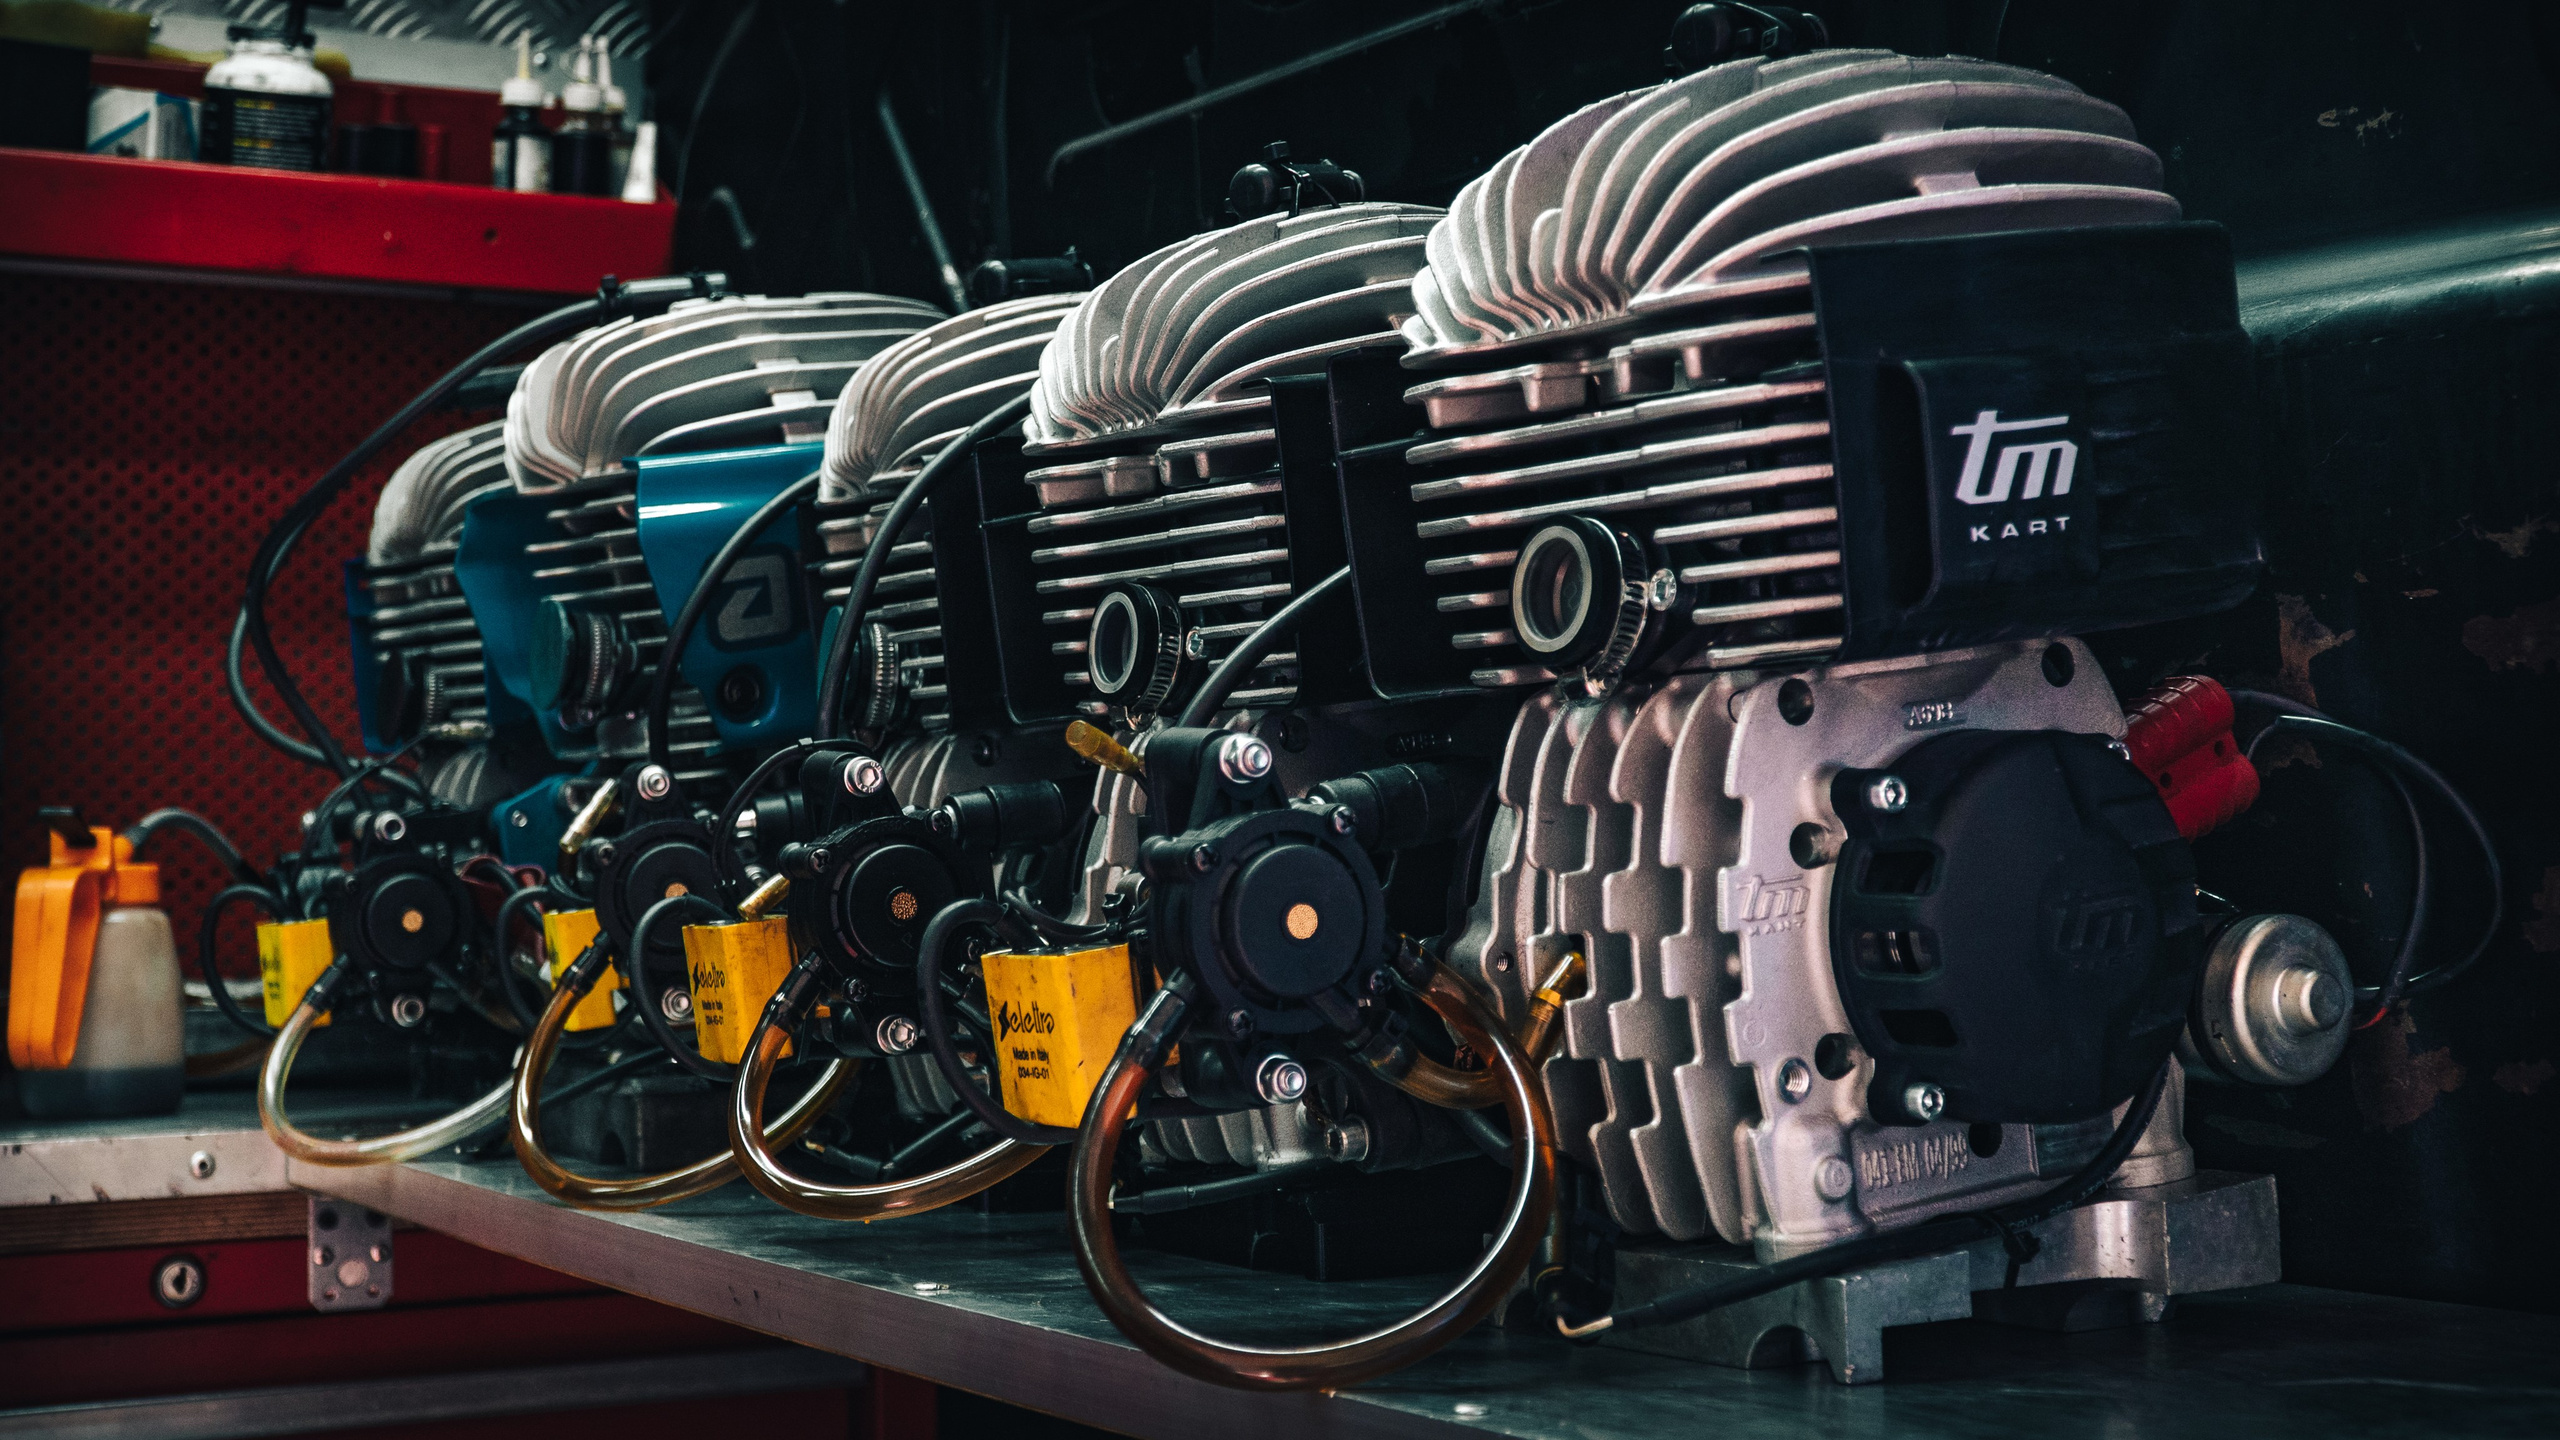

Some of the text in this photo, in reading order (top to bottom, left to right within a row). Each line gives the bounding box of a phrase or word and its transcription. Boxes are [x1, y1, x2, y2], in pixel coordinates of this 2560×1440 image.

[1950, 410, 2079, 505] tm
[1970, 516, 2071, 542] KART
[1013, 1047, 1050, 1065] Made in Italy
